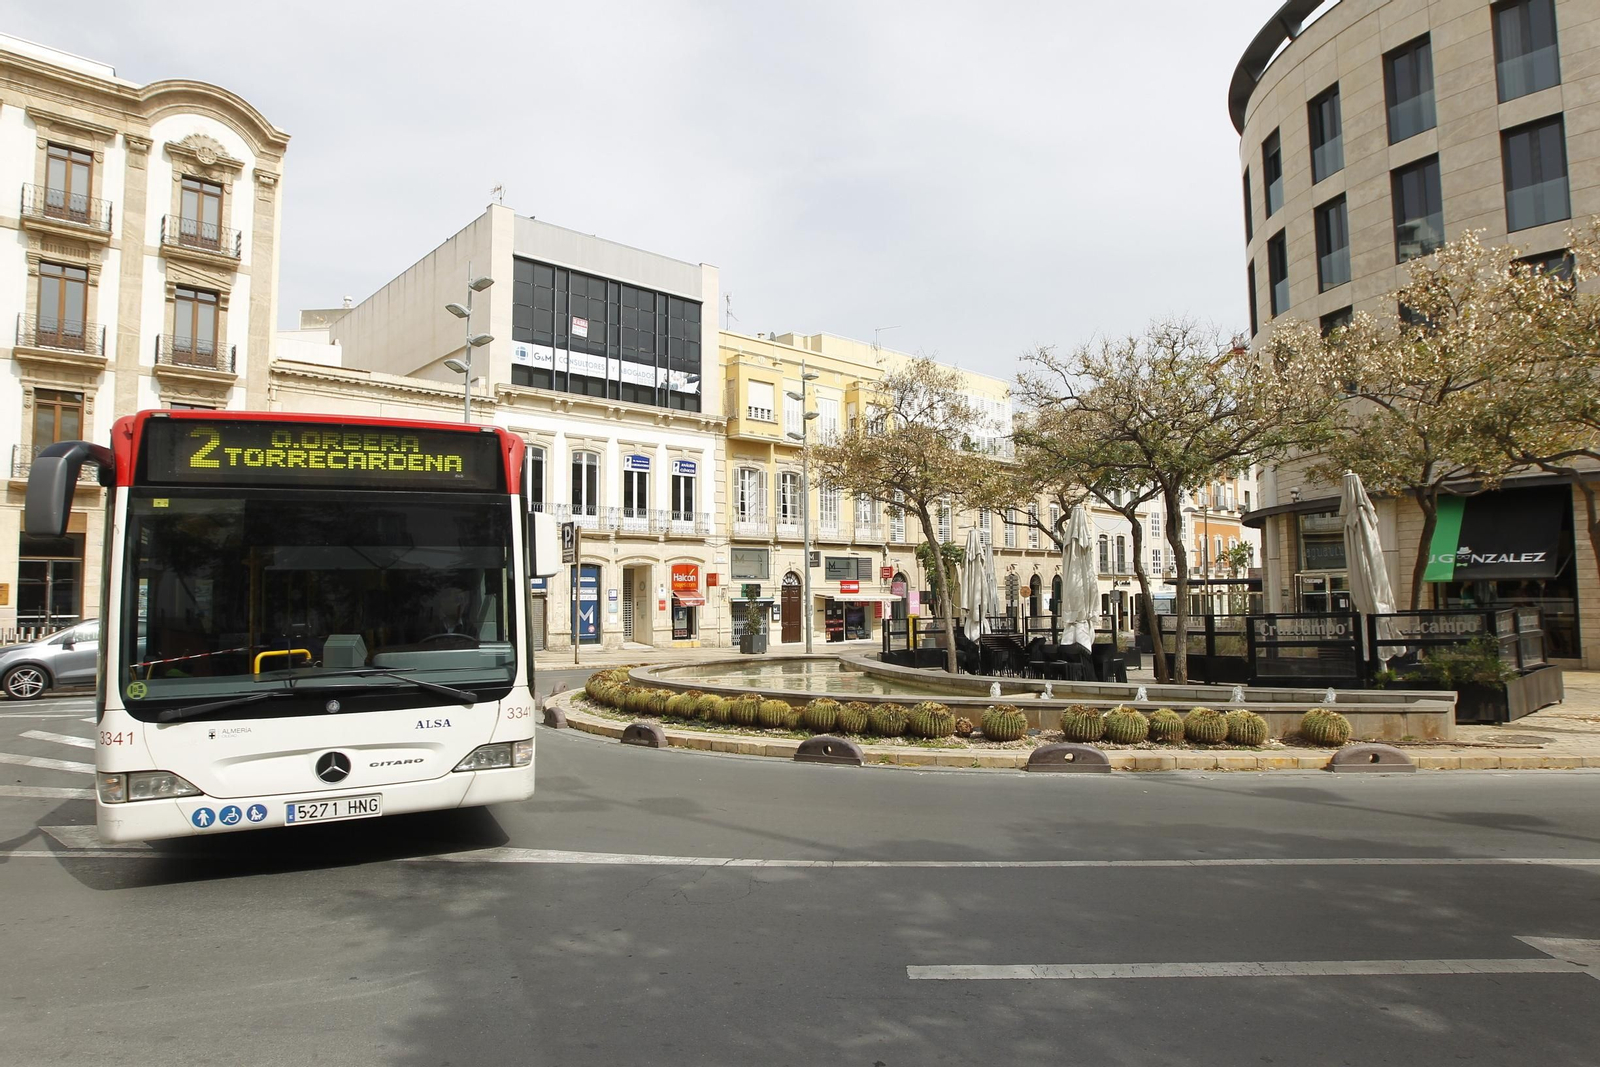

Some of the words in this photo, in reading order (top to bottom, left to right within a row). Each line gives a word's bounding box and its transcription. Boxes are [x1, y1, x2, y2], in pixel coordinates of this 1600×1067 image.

[190, 427, 220, 468] 2
[224, 447, 462, 472] TORRECARDENA
[673, 568, 696, 582] Halcón
[1260, 622, 1346, 639] Cruzcampo
[507, 707, 532, 719] 3341
[415, 718, 452, 730] ALSA
[100, 731, 134, 746] 3341
[369, 758, 425, 768] CITARO
[298, 801, 338, 819] 5271
[348, 798, 378, 814] HNG
